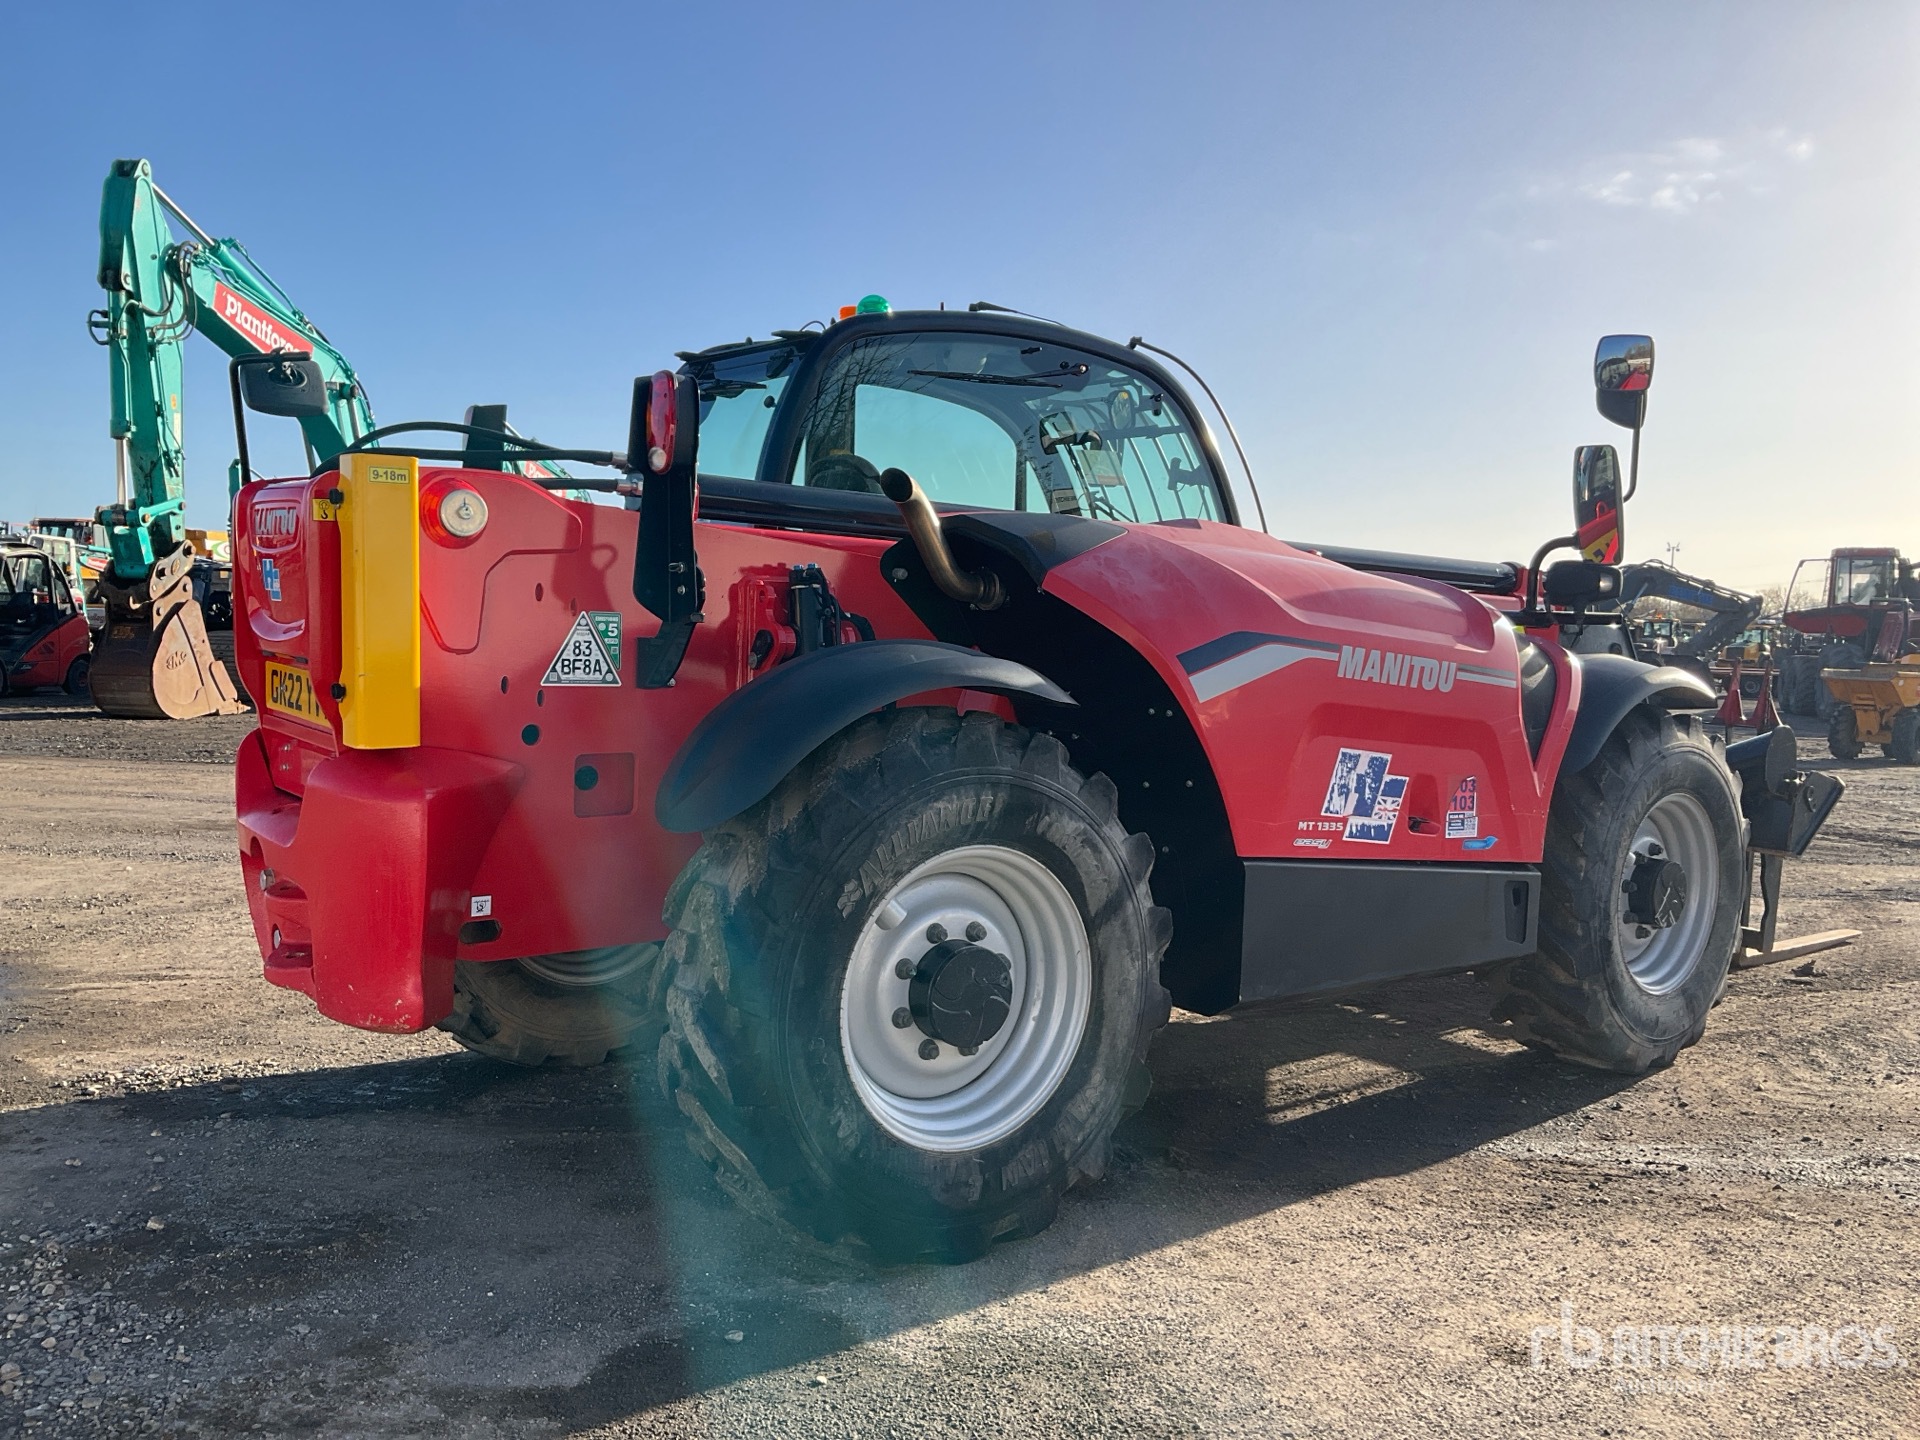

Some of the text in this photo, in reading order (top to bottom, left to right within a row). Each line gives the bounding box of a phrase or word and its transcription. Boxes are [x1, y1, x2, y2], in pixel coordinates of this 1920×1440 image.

[372, 469, 407, 481] 9-18m
[607, 623, 618, 637] 5
[572, 640, 592, 657] 83
[561, 658, 602, 676] BF8A
[1337, 645, 1457, 693] MANITOU
[271, 669, 302, 711] GK22
[1298, 821, 1344, 831] MT 1335
[858, 796, 994, 898] ALLIANCE
